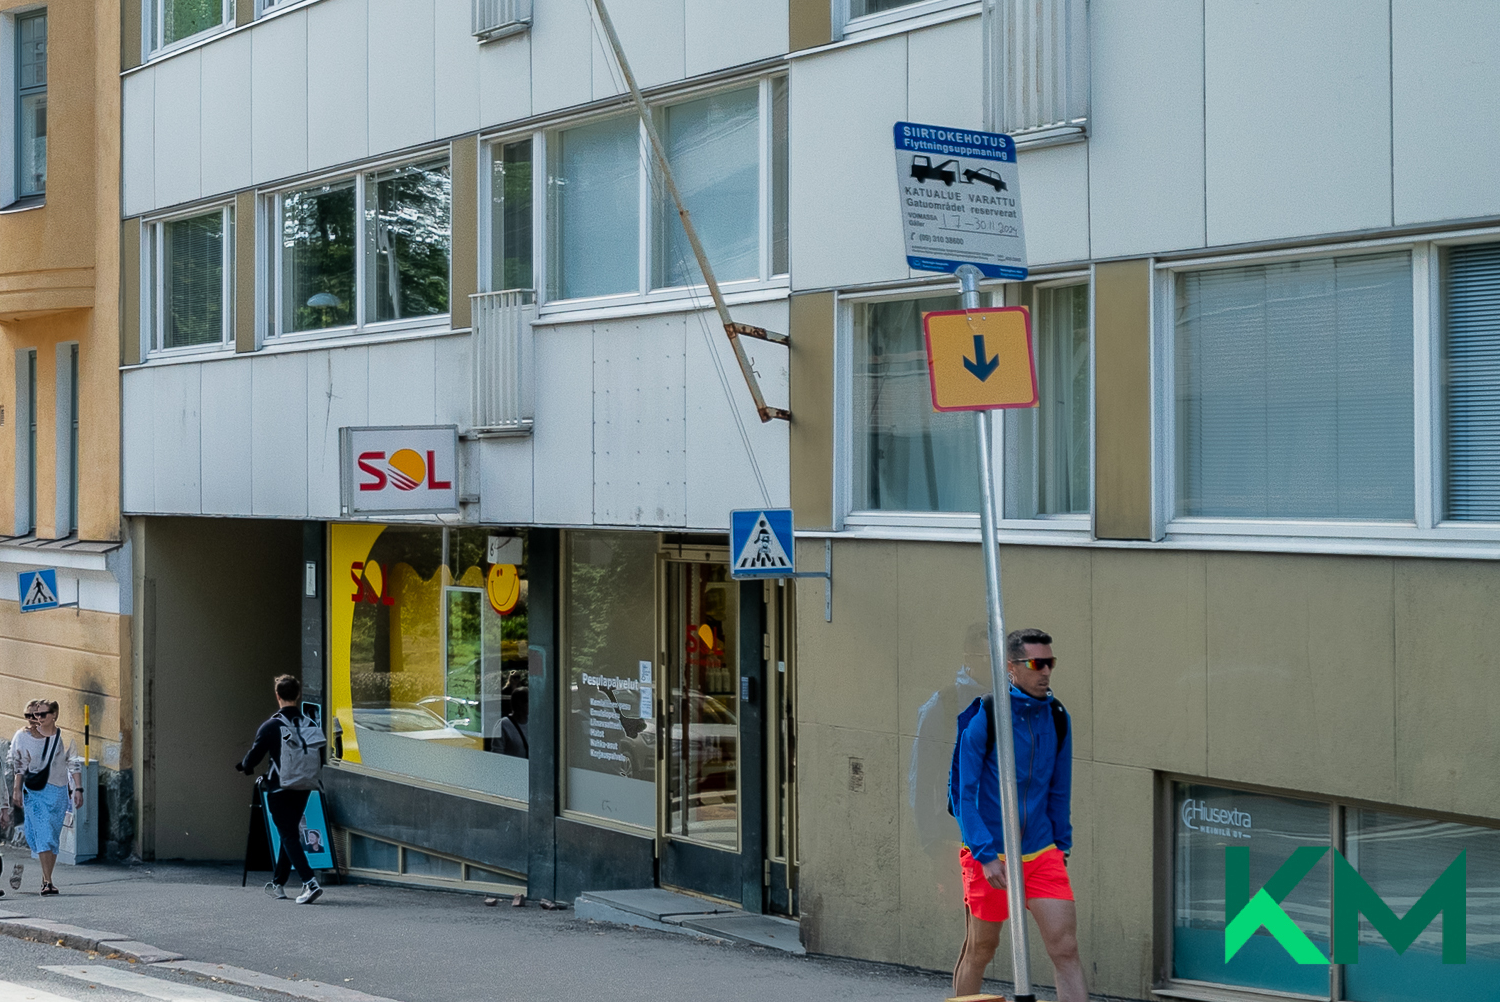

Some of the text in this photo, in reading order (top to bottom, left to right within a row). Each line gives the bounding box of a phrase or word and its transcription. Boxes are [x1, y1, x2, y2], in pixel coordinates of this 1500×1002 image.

[903, 126, 1007, 148] SIIRTOKEHOTUS
[904, 138, 1008, 160] Flyttningsuppmaning
[905, 187, 1016, 207] KATUALUE VARATTU
[906, 198, 1017, 219] Gatuområdet reserverat
[933, 235, 945, 244] 310
[357, 448, 452, 491] SOL
[350, 559, 395, 606] SOL
[685, 623, 725, 656] SOL
[582, 672, 639, 691] Pesulapalvelut
[1191, 799, 1252, 828] Hiusextra
[1200, 825, 1231, 837] HEINILÄ
